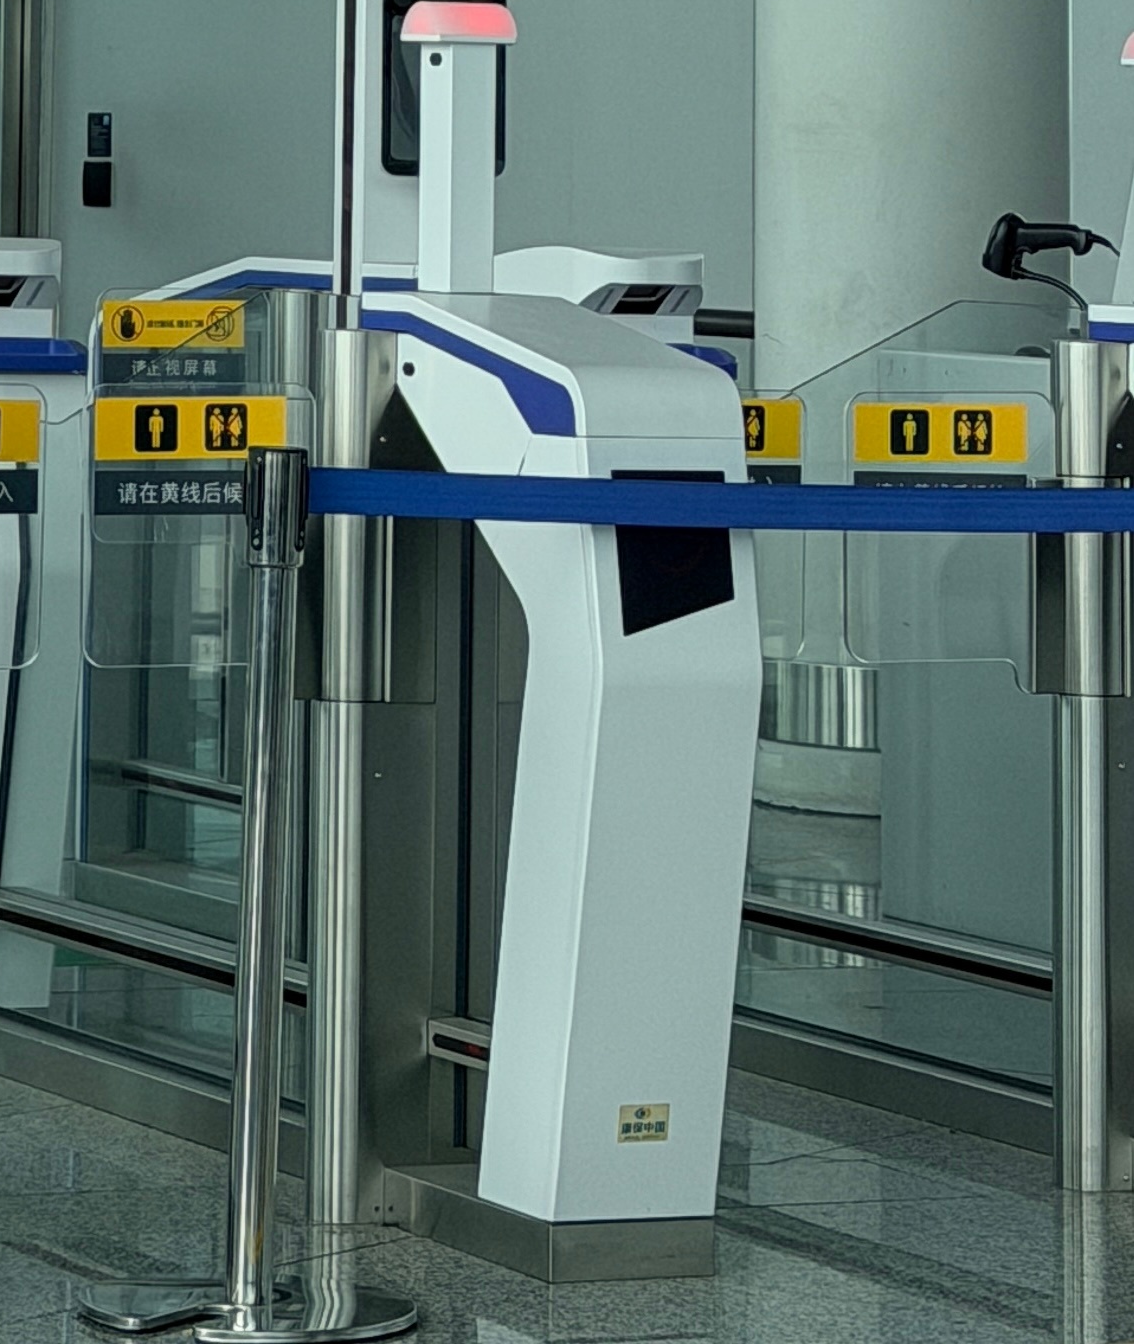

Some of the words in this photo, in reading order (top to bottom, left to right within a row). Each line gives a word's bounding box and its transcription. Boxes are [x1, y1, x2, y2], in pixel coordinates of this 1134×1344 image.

[117, 481, 244, 506] 请在黄线后候
